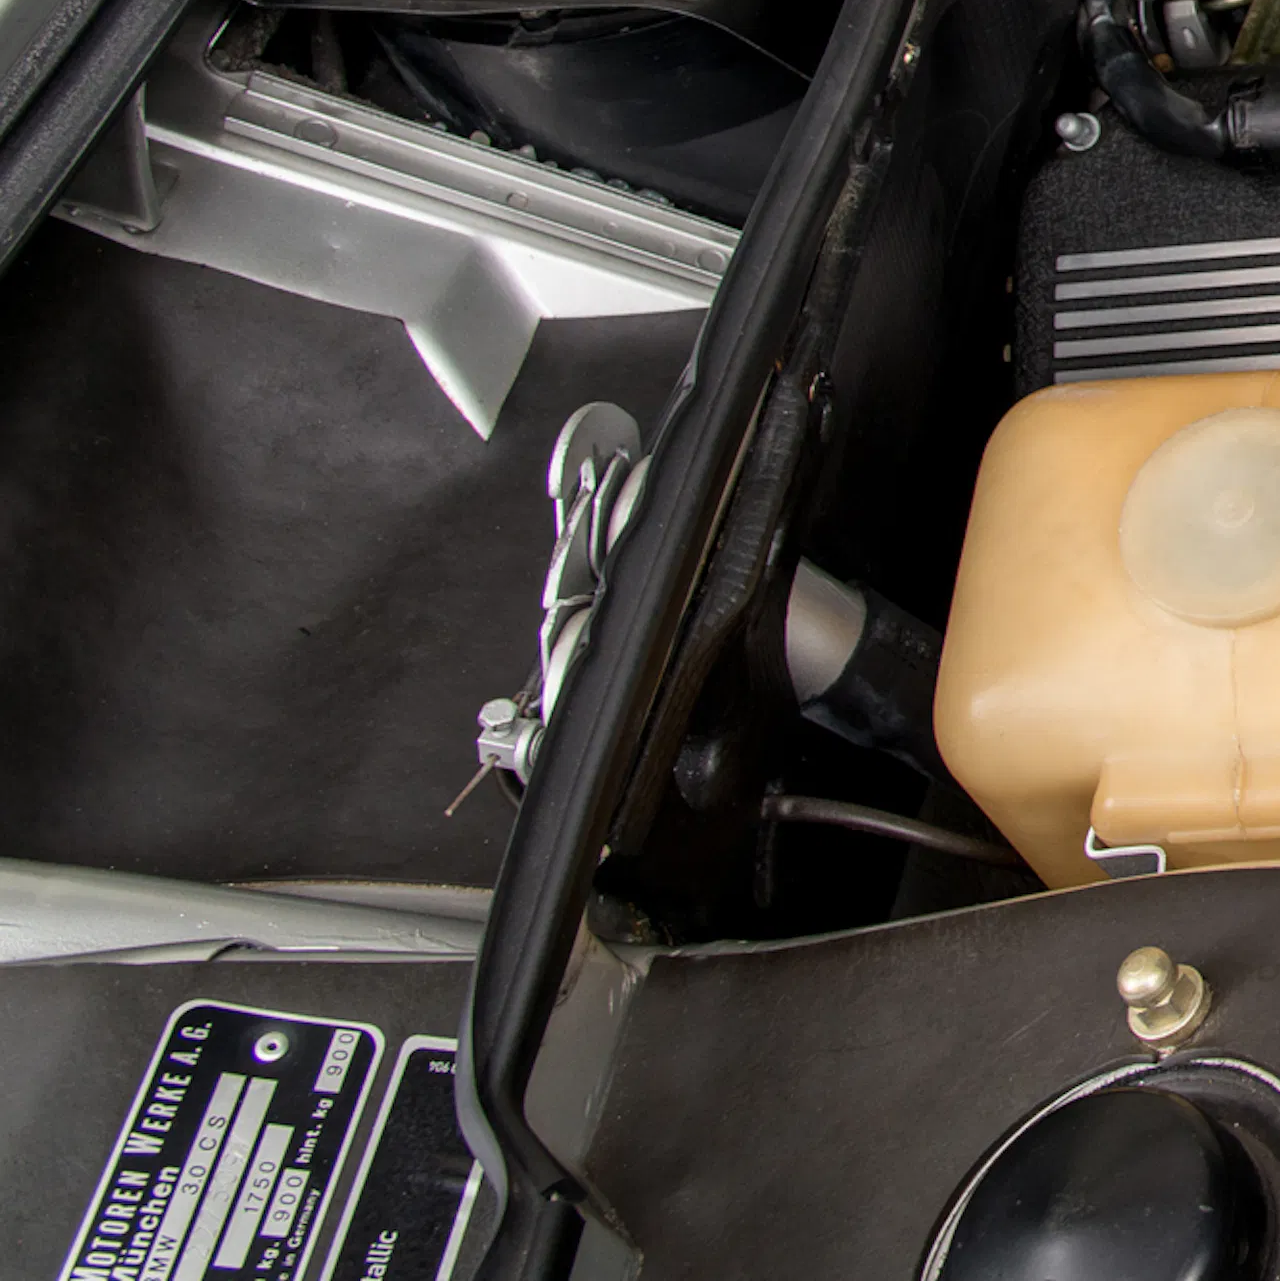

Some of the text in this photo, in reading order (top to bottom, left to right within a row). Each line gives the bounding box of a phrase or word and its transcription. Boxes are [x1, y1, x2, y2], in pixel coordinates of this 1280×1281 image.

[70, 1170, 150, 1281] MOTOREN
[123, 1072, 192, 1154] WERKE
[182, 1165, 206, 1196] 3.0
[243, 1161, 276, 1212] 1750
[256, 1241, 282, 1271] kg.
[273, 1176, 303, 1222] 900
[312, 1098, 334, 1119] kg
[327, 1033, 354, 1076] 900
[111, 1165, 182, 1281] München
[287, 1188, 320, 1249] Germany
